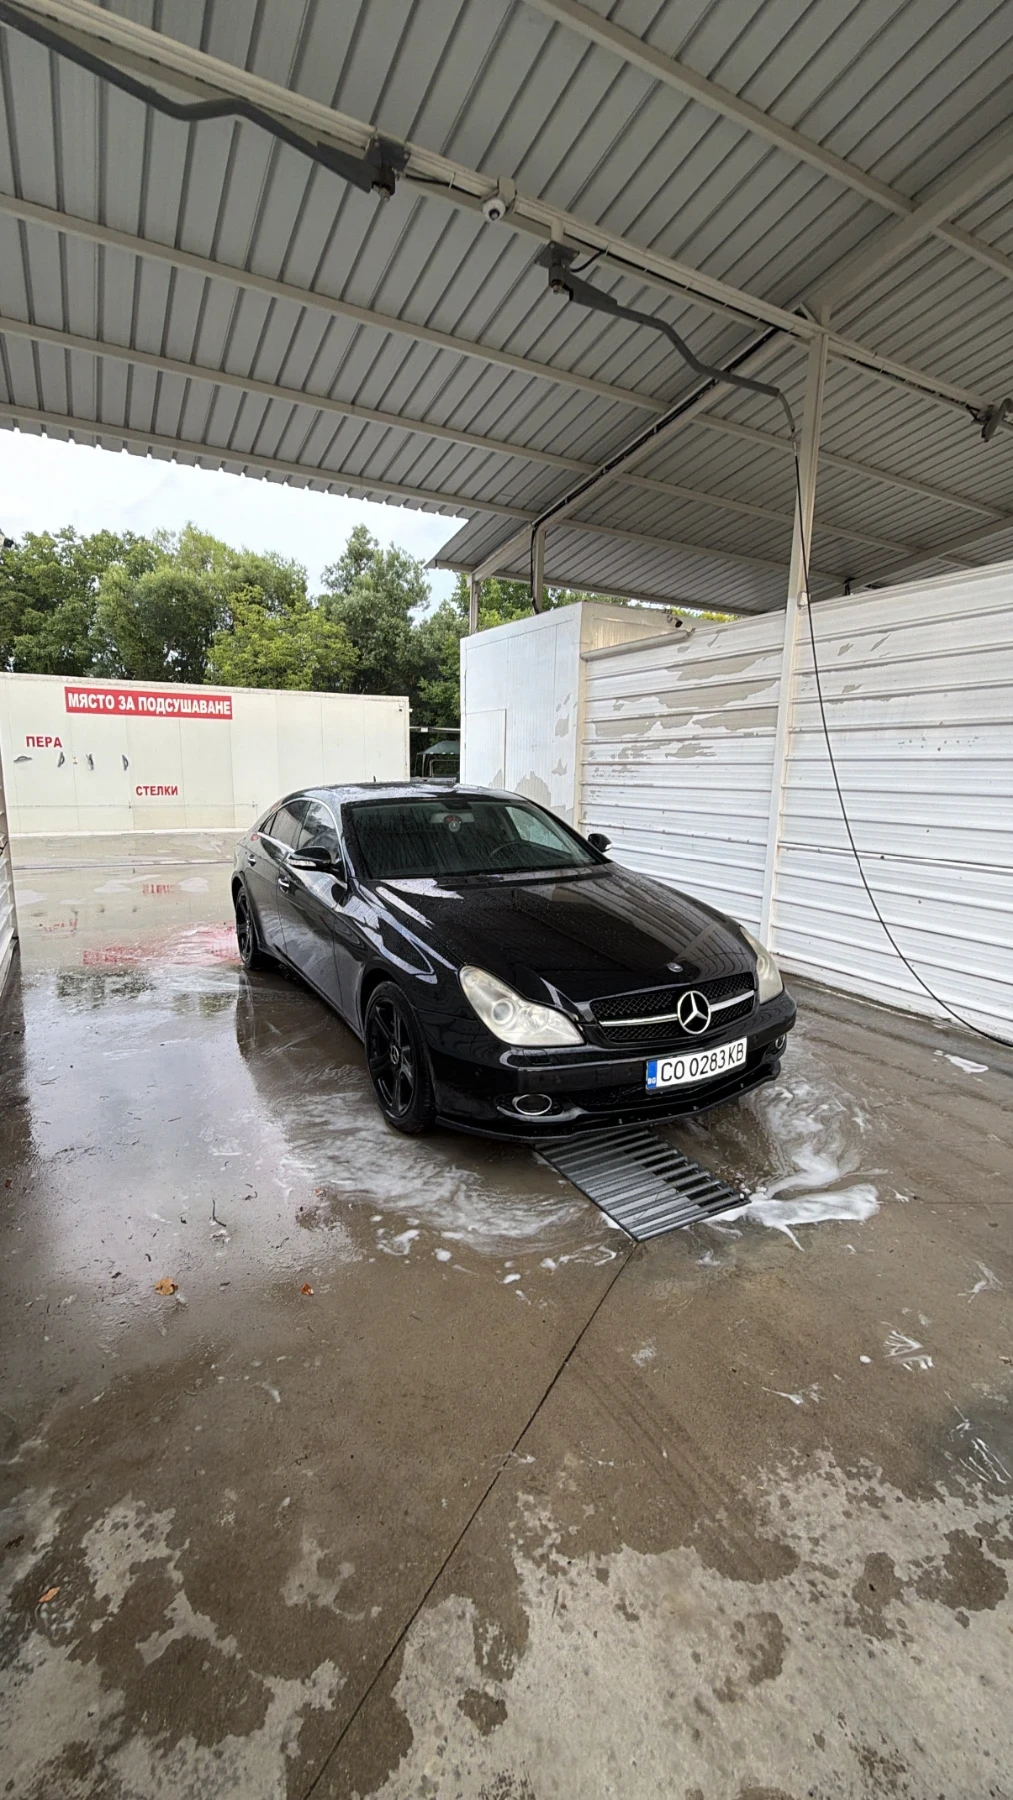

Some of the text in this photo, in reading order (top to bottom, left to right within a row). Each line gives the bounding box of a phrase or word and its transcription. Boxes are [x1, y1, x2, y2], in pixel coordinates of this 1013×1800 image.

[68, 693, 231, 715] МЯСТО ЗА ПОДСУШАВАНЕ
[26, 736, 62, 748] ПЕРА
[135, 786, 179, 796] СТЕЛКИ
